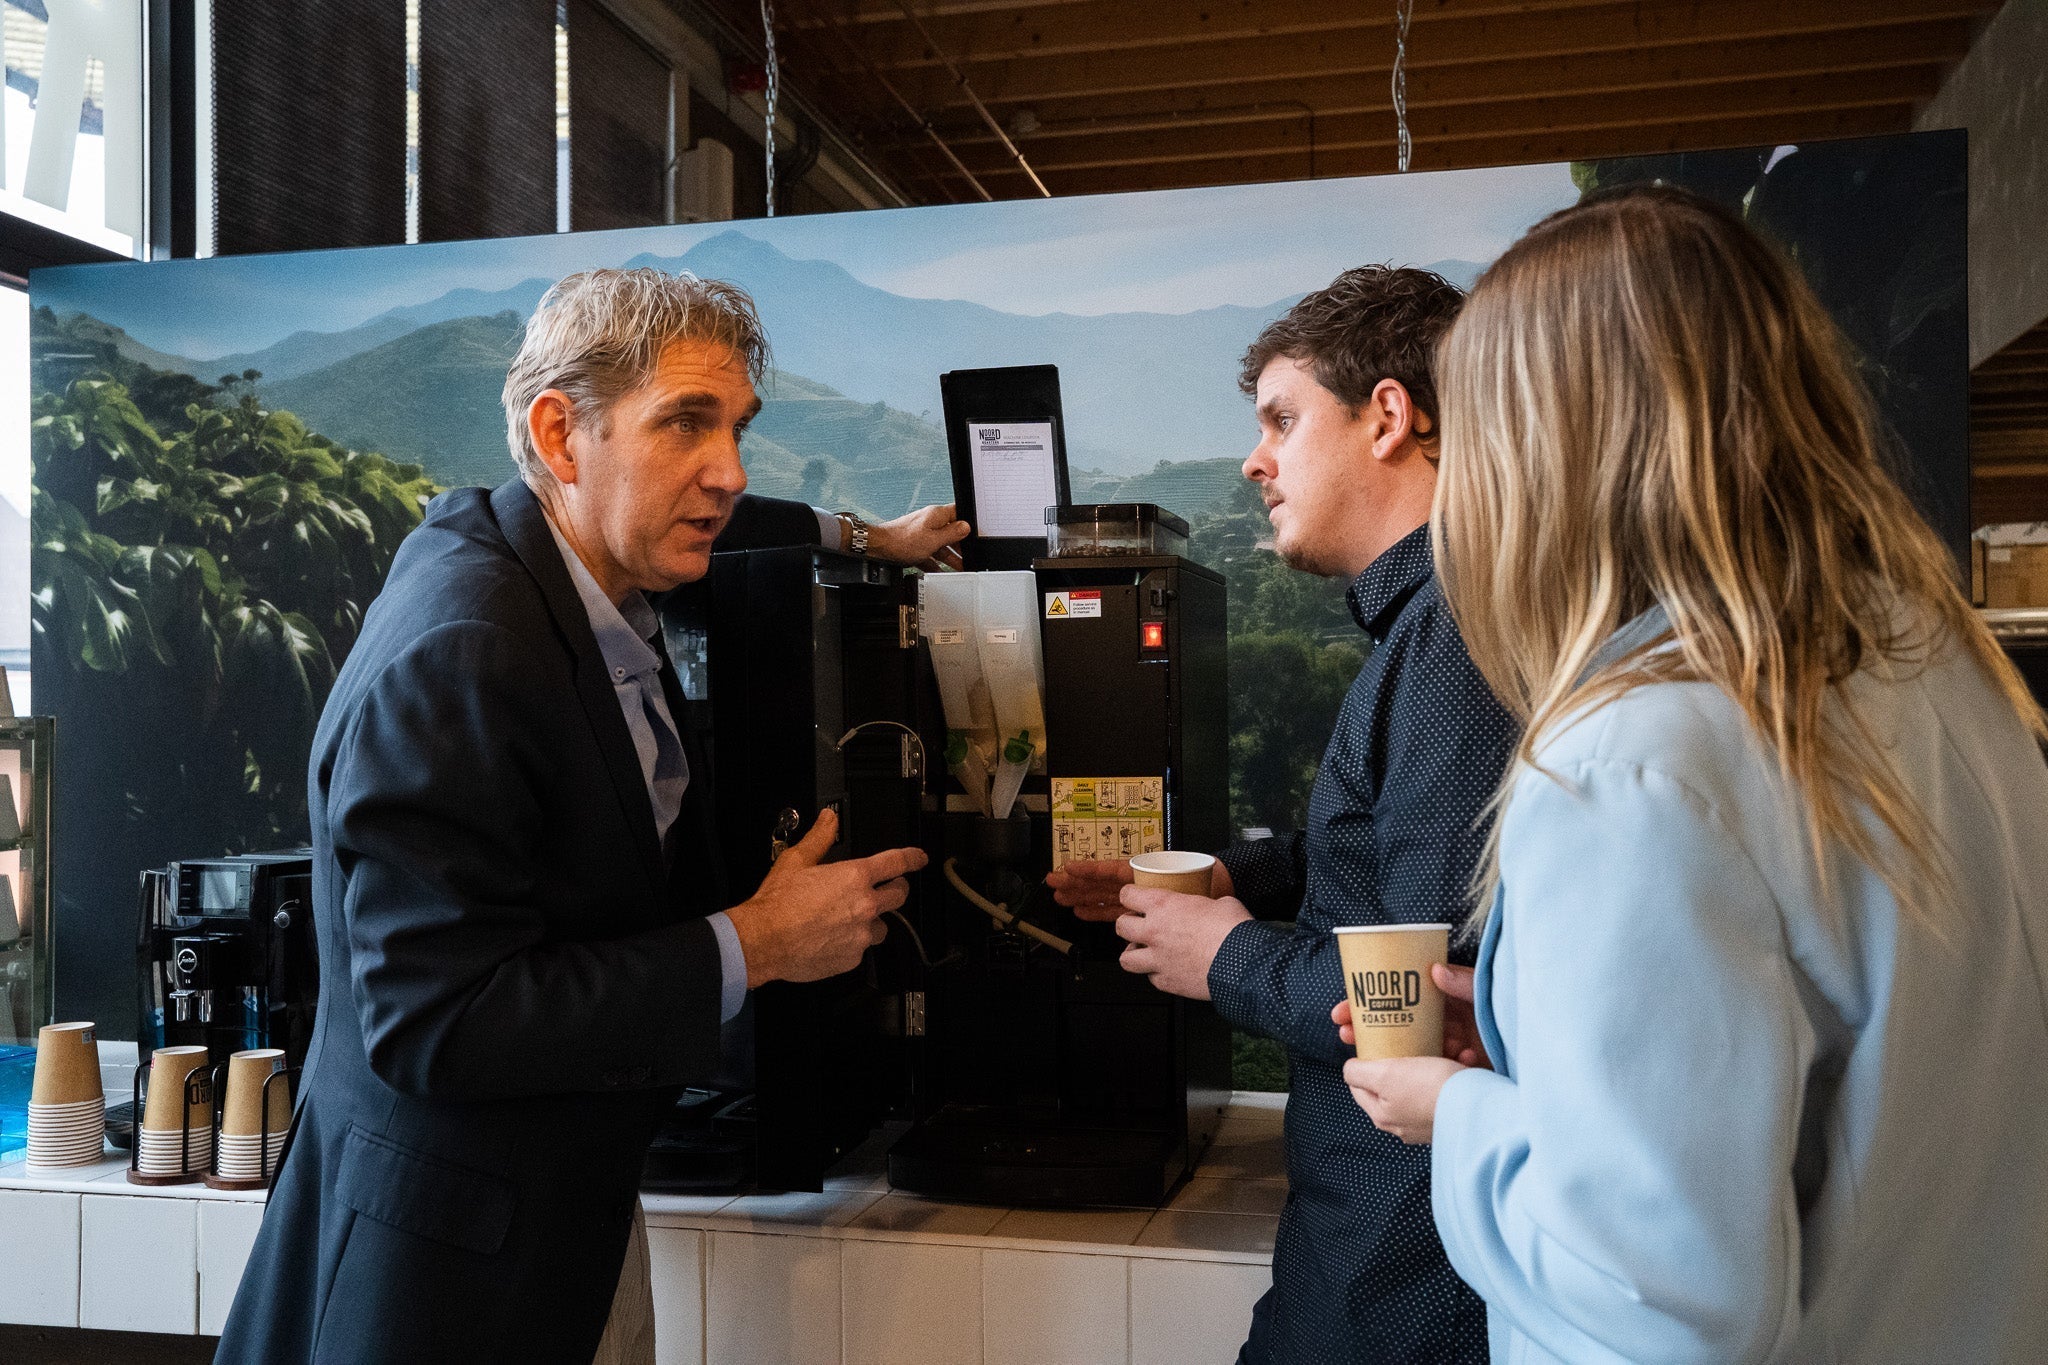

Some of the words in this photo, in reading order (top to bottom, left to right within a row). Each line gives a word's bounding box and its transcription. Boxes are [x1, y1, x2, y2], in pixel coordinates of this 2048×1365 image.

[979, 428, 1001, 440] NOORD
[1352, 970, 1420, 1007] NOORD
[1362, 1013, 1414, 1023] ROASTERS
